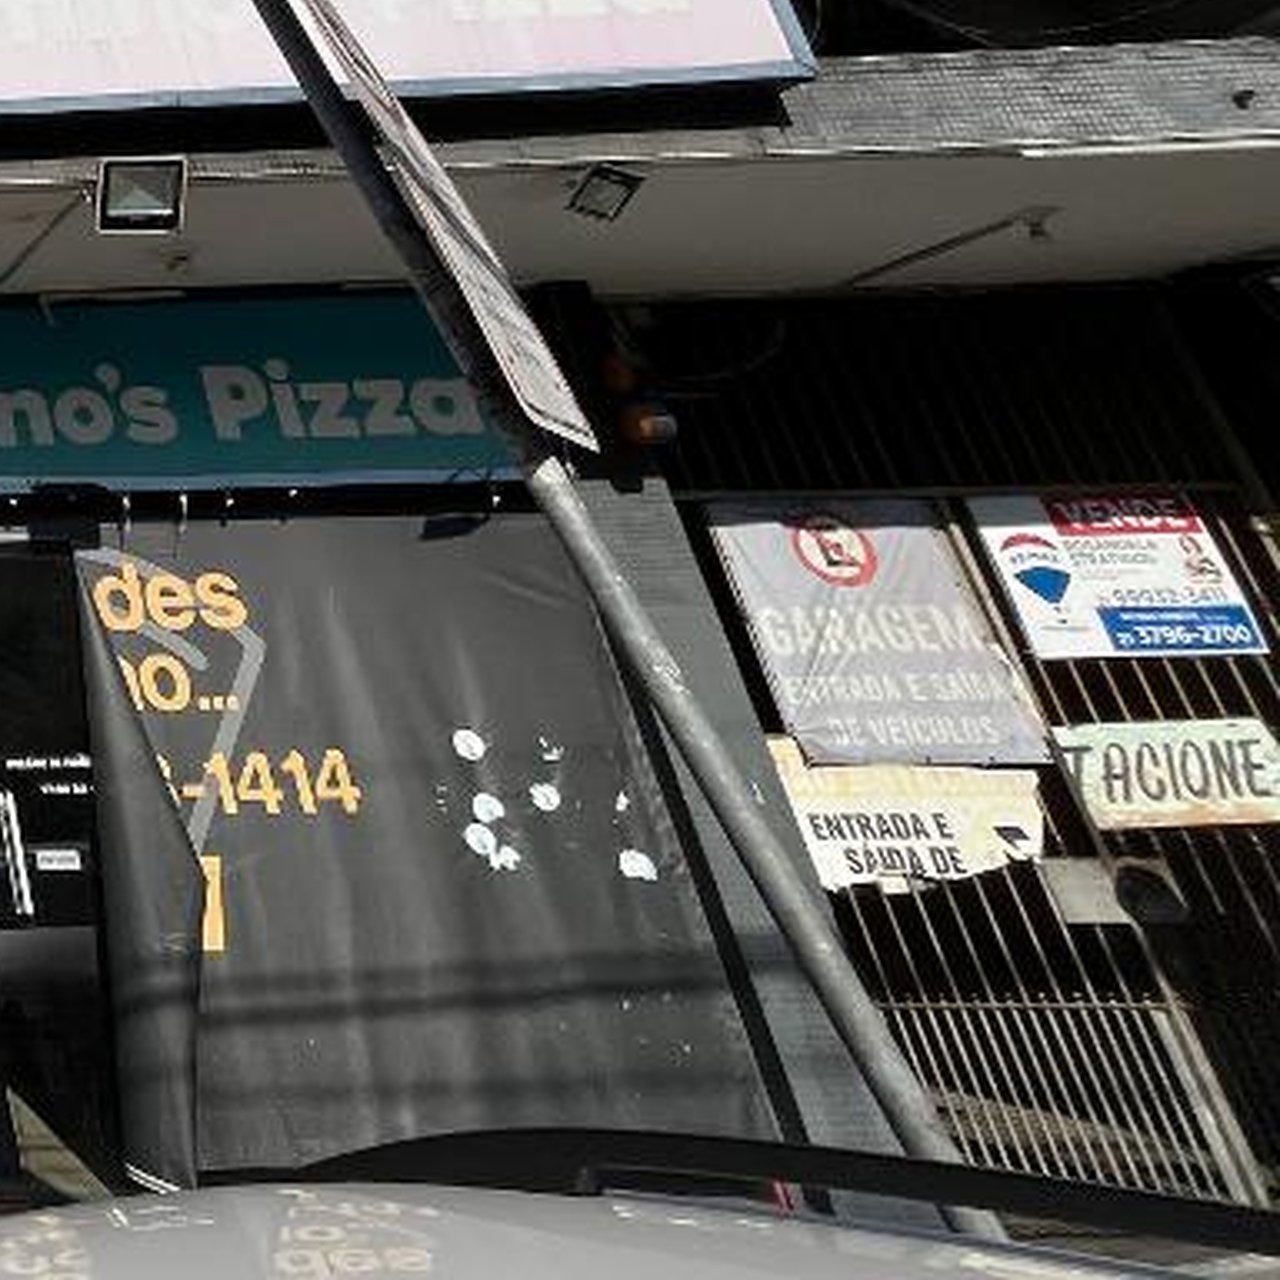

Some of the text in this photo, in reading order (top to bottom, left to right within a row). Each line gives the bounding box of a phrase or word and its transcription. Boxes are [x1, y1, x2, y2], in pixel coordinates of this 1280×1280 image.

[200, 357, 488, 442] Pizza
[757, 604, 987, 656] GARAGEM
[907, 675, 929, 702] E
[827, 717, 867, 746] DE
[808, 813, 955, 840] ENTRADA E
[929, 846, 968, 874] DE
